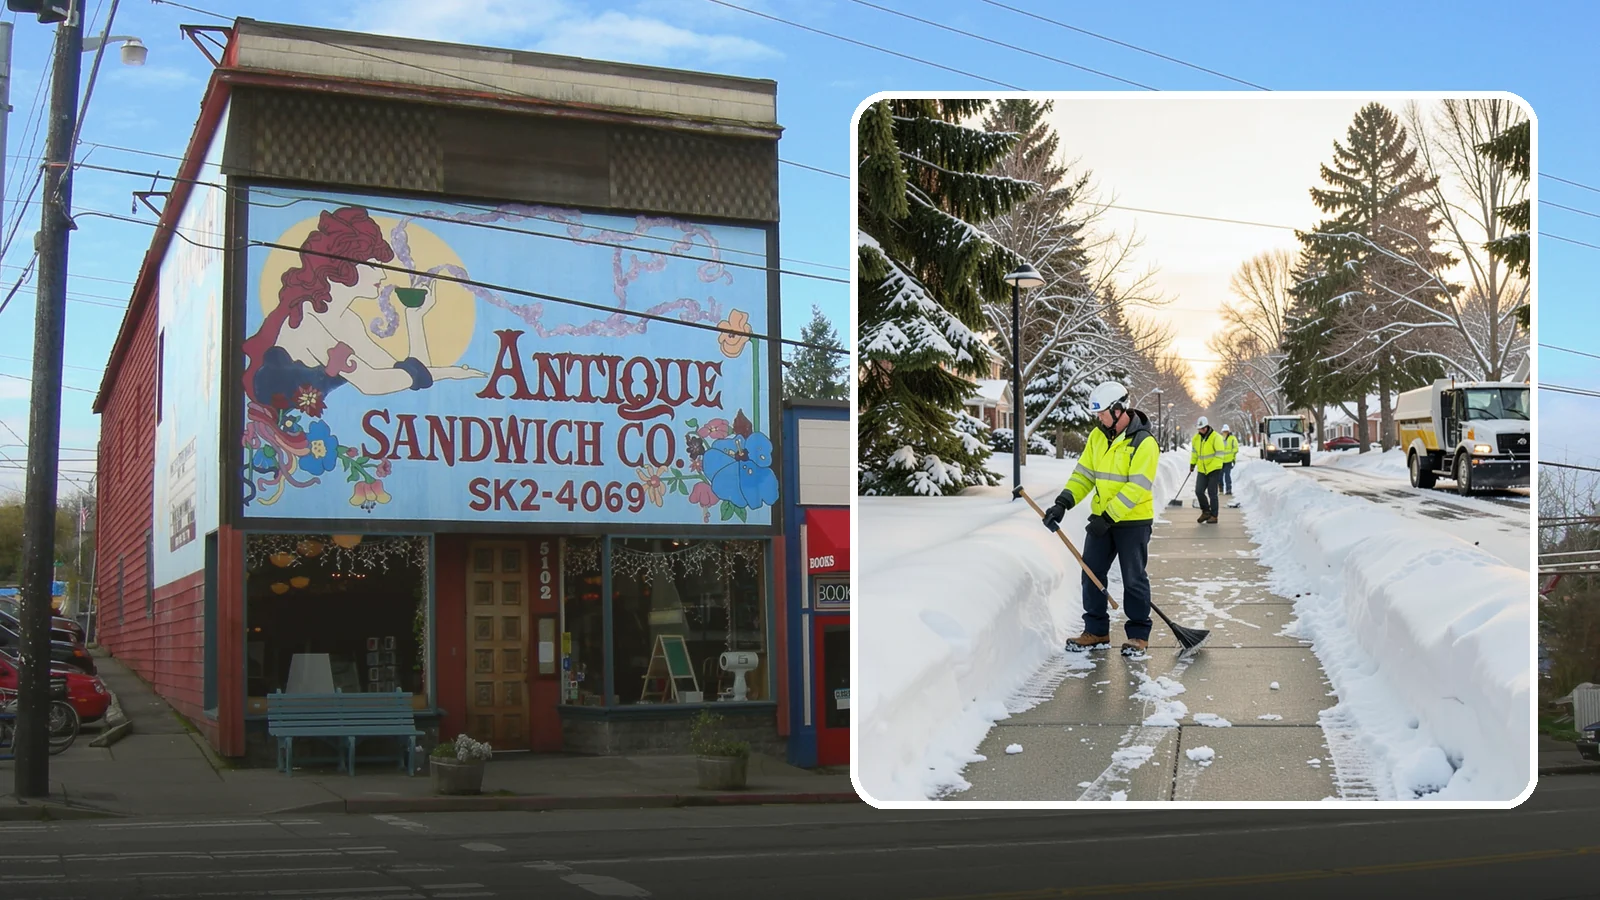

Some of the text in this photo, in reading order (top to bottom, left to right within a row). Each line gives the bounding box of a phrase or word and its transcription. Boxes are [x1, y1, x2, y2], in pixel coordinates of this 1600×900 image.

[476, 329, 723, 420] ANTIQUE
[361, 408, 685, 468] SANDWICH CO.
[468, 477, 645, 513] SK2-4069
[539, 542, 551, 600] 5102
[809, 555, 835, 569] BOOKS
